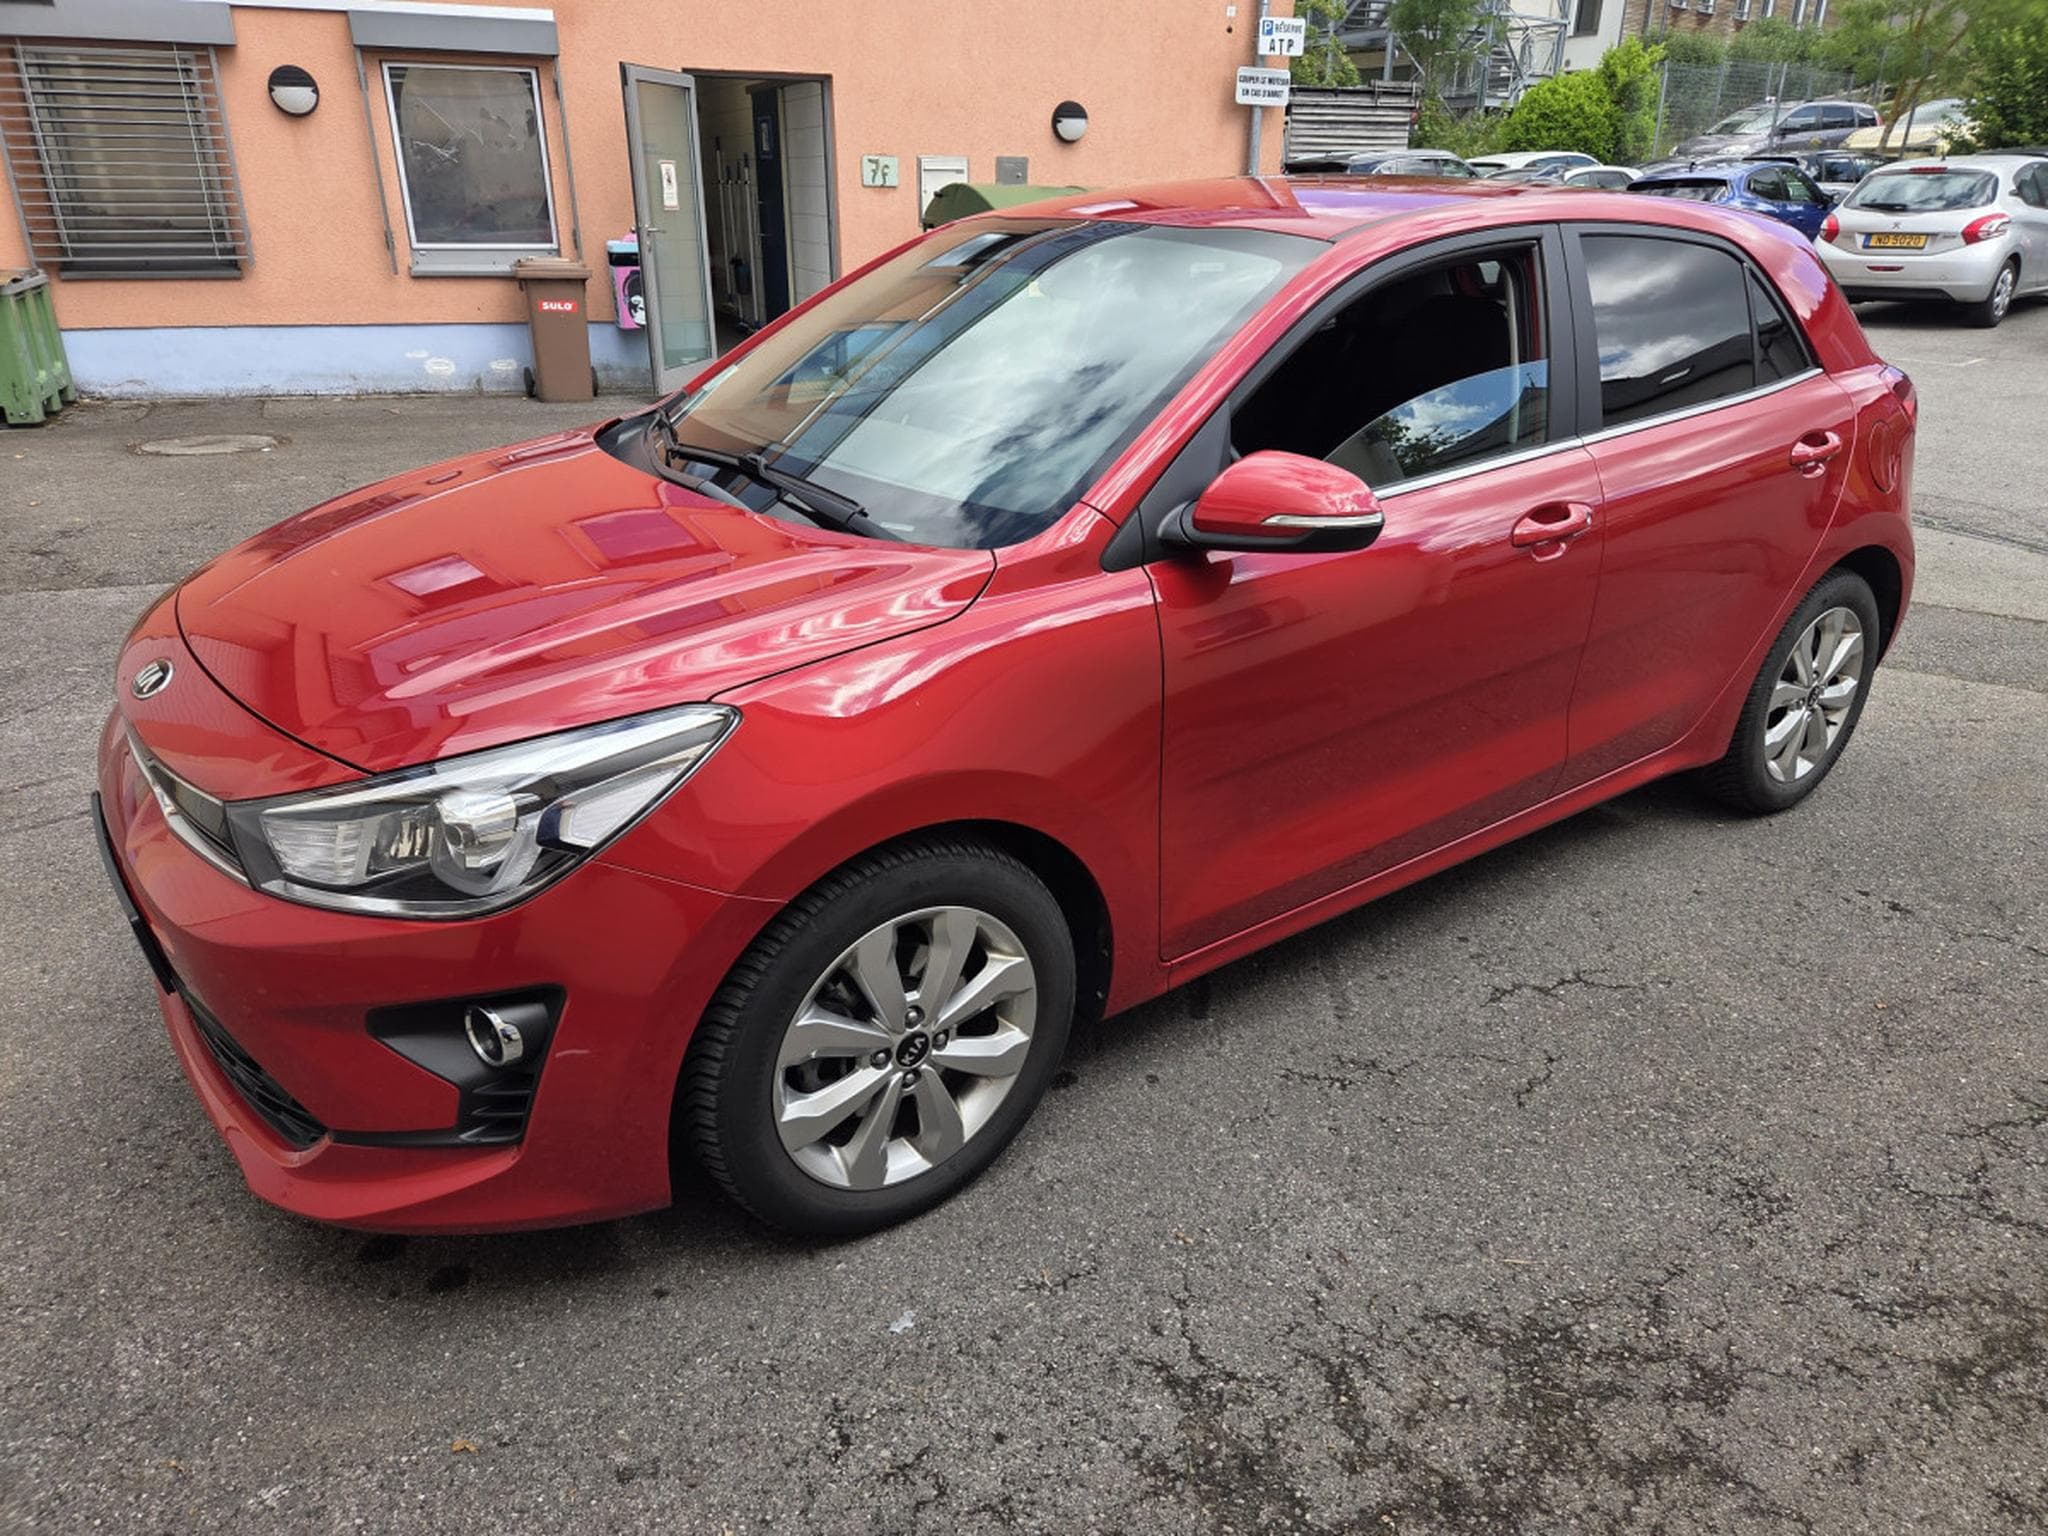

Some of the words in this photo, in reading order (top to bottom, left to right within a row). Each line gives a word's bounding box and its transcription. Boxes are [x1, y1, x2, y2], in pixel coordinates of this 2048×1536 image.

[1251, 89, 1261, 97] CAS
[542, 301, 573, 311] SULO
[901, 1037, 926, 1065] KIA
